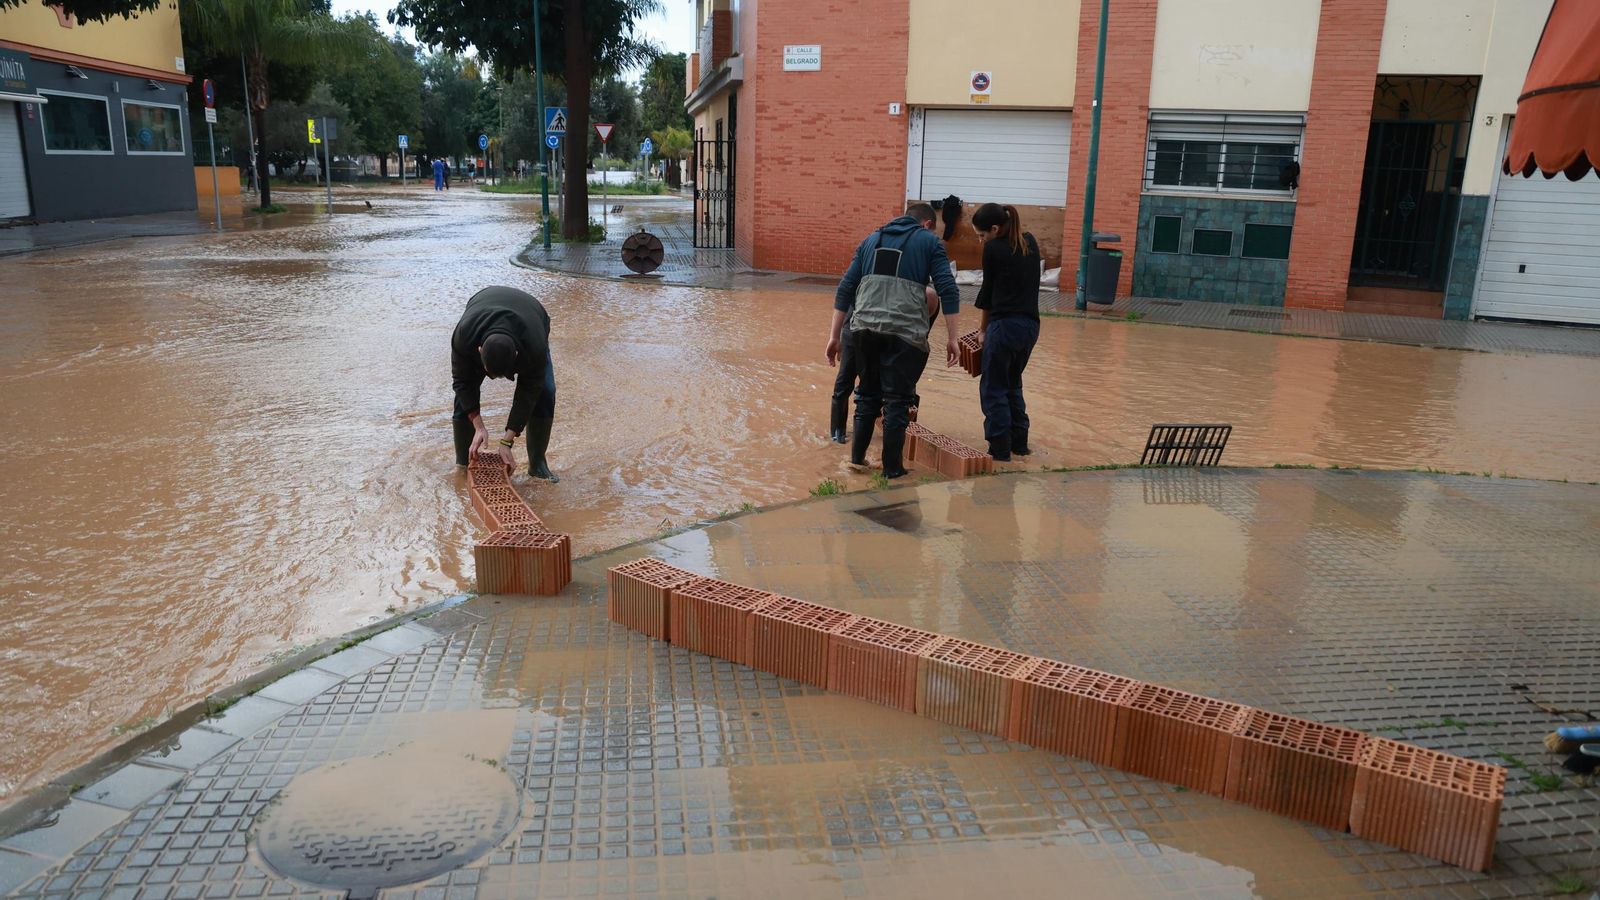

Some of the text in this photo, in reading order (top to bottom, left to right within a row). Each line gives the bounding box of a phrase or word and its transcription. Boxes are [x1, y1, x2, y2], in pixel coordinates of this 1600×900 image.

[785, 57, 819, 65] BELGRADO
[892, 105, 897, 113] 1
[1485, 115, 1494, 126] 3
